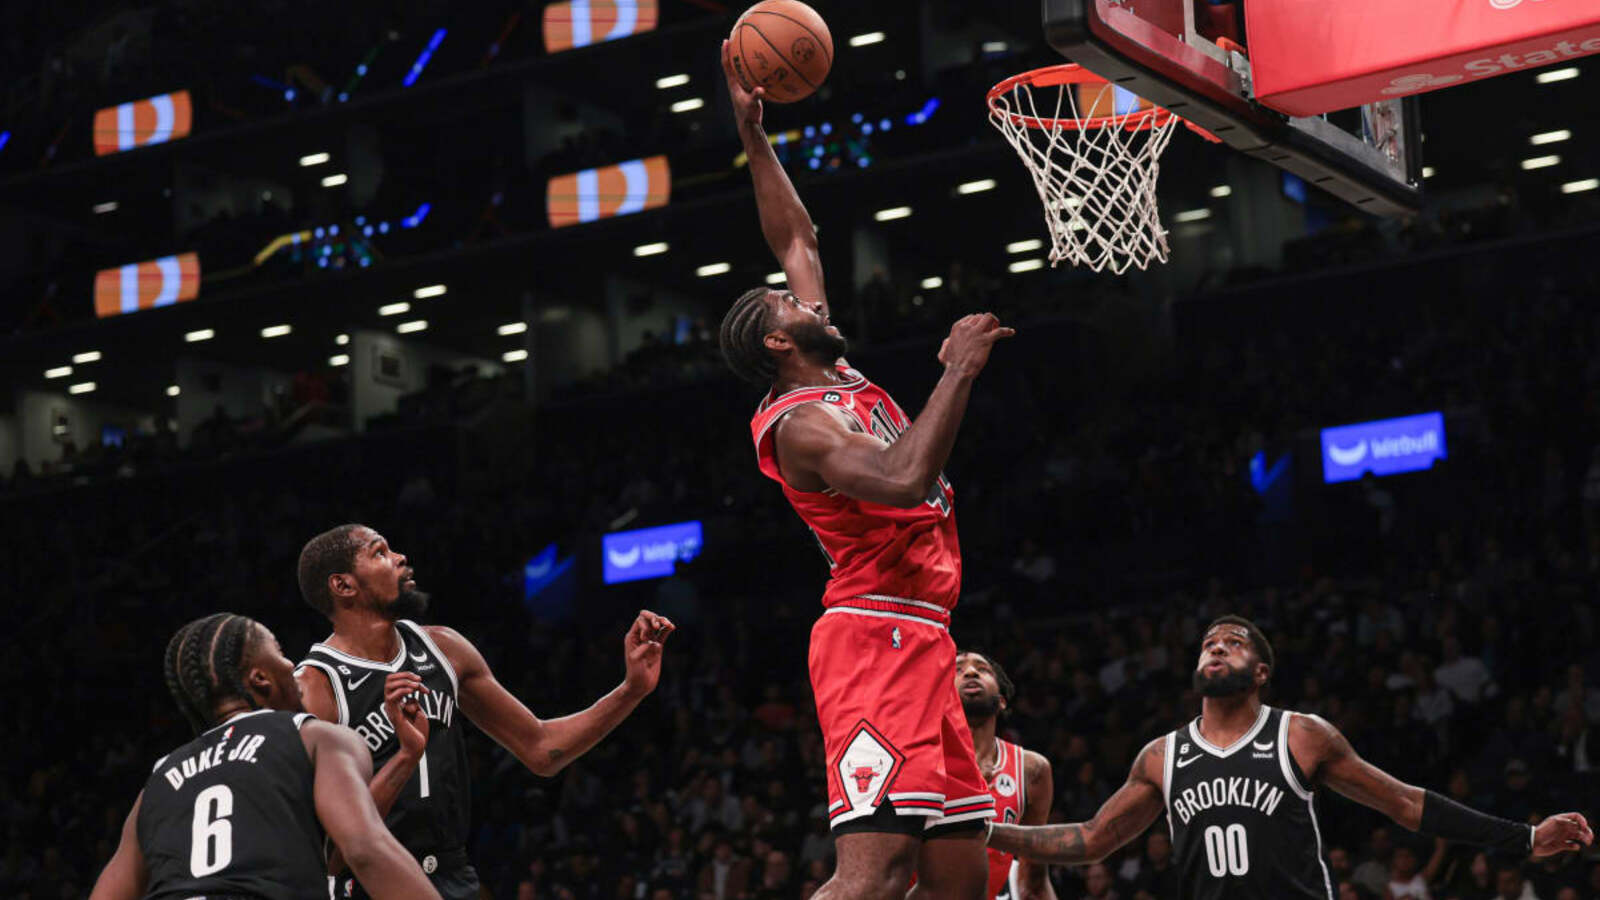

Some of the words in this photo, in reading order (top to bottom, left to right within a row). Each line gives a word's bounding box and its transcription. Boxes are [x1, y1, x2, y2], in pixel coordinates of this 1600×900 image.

[165, 740, 227, 791] DUKE
[228, 734, 266, 764] JR.
[1174, 777, 1284, 825] BROOKLYN
[190, 784, 234, 878] 6
[1204, 823, 1249, 878] 00
